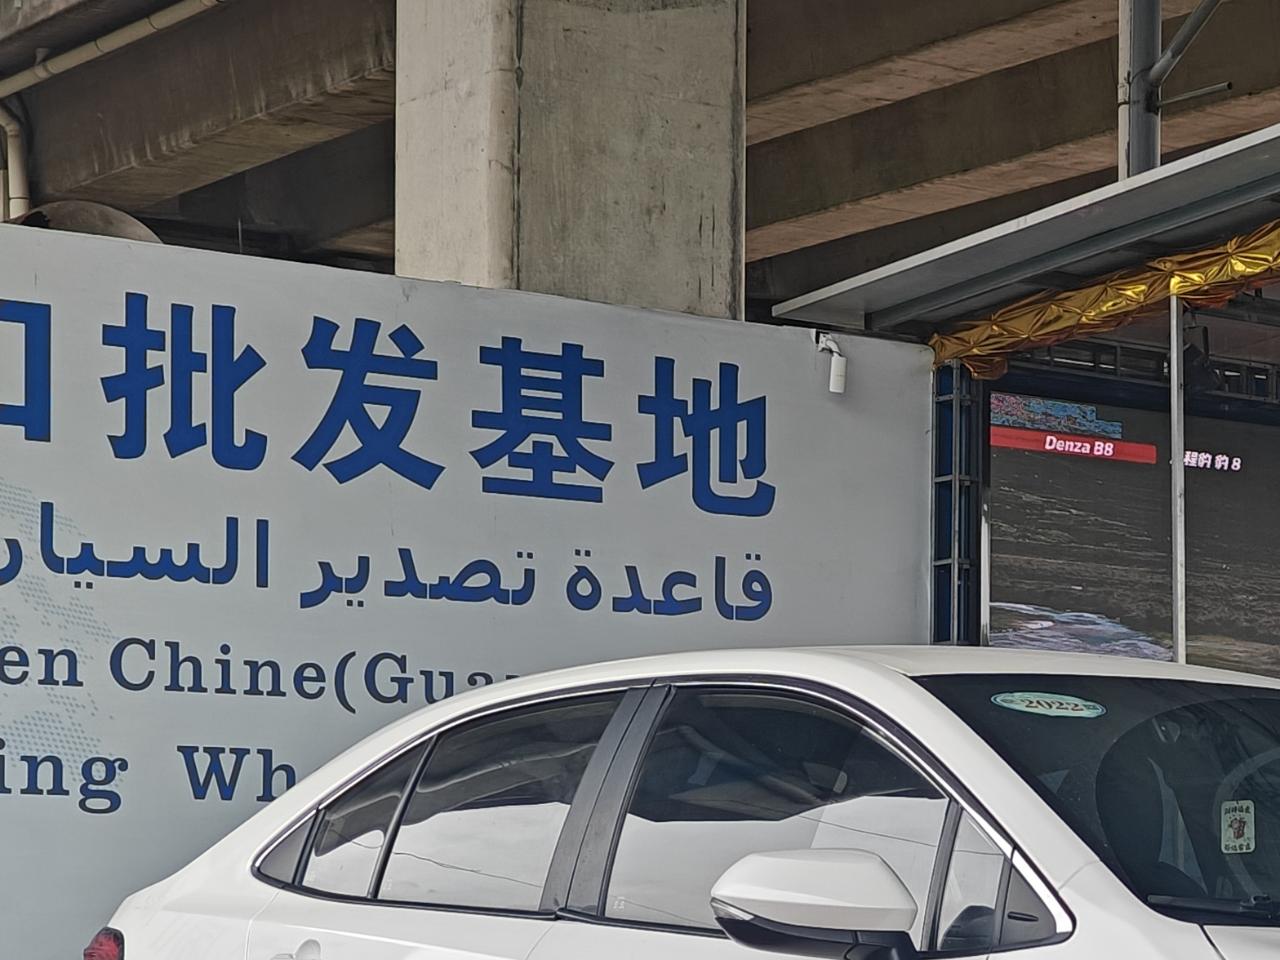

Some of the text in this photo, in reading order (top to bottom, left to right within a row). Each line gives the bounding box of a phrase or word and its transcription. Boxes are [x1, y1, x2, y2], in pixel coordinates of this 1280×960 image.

[1045, 434, 1114, 456] Denza B8
[1230, 456, 1242, 471] 8
[300, 547, 536, 609] تصدير
[566, 548, 773, 621] قاعدة
